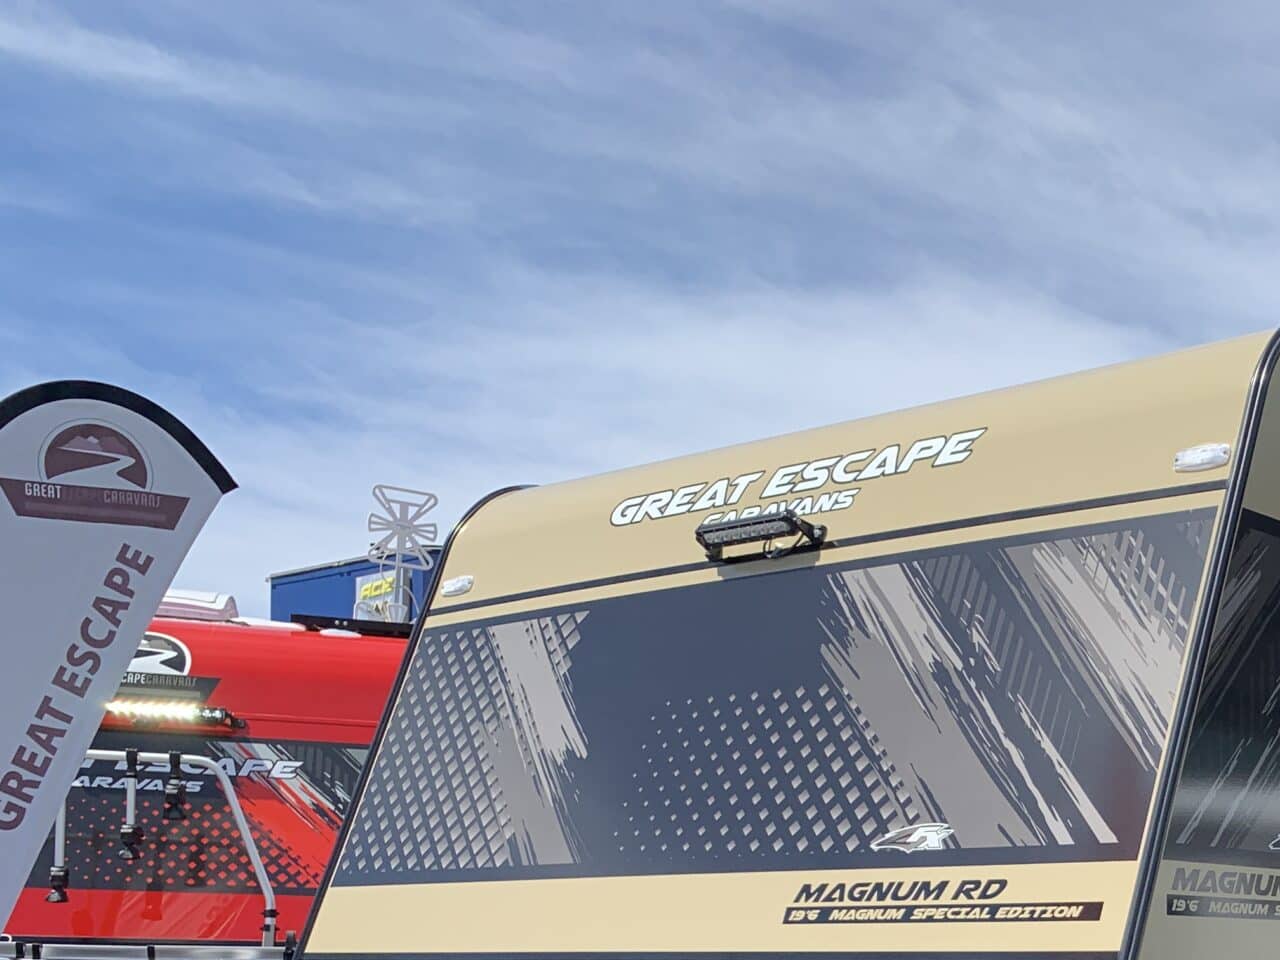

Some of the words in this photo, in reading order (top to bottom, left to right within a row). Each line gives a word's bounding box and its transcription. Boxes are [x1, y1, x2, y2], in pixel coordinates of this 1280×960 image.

[610, 470, 764, 527] GREAT
[760, 427, 989, 499] ESCAPE
[24, 481, 62, 499] GREAT
[0, 696, 74, 832] GREAT
[52, 543, 155, 699] ESCAPE
[793, 880, 950, 903] MAGNUM
[952, 879, 1008, 900] RD
[828, 908, 903, 921] MAGNUM
[910, 907, 994, 920] SPECIAL
[997, 905, 1083, 919] EDITION
[1208, 901, 1269, 916] MAGNUM
